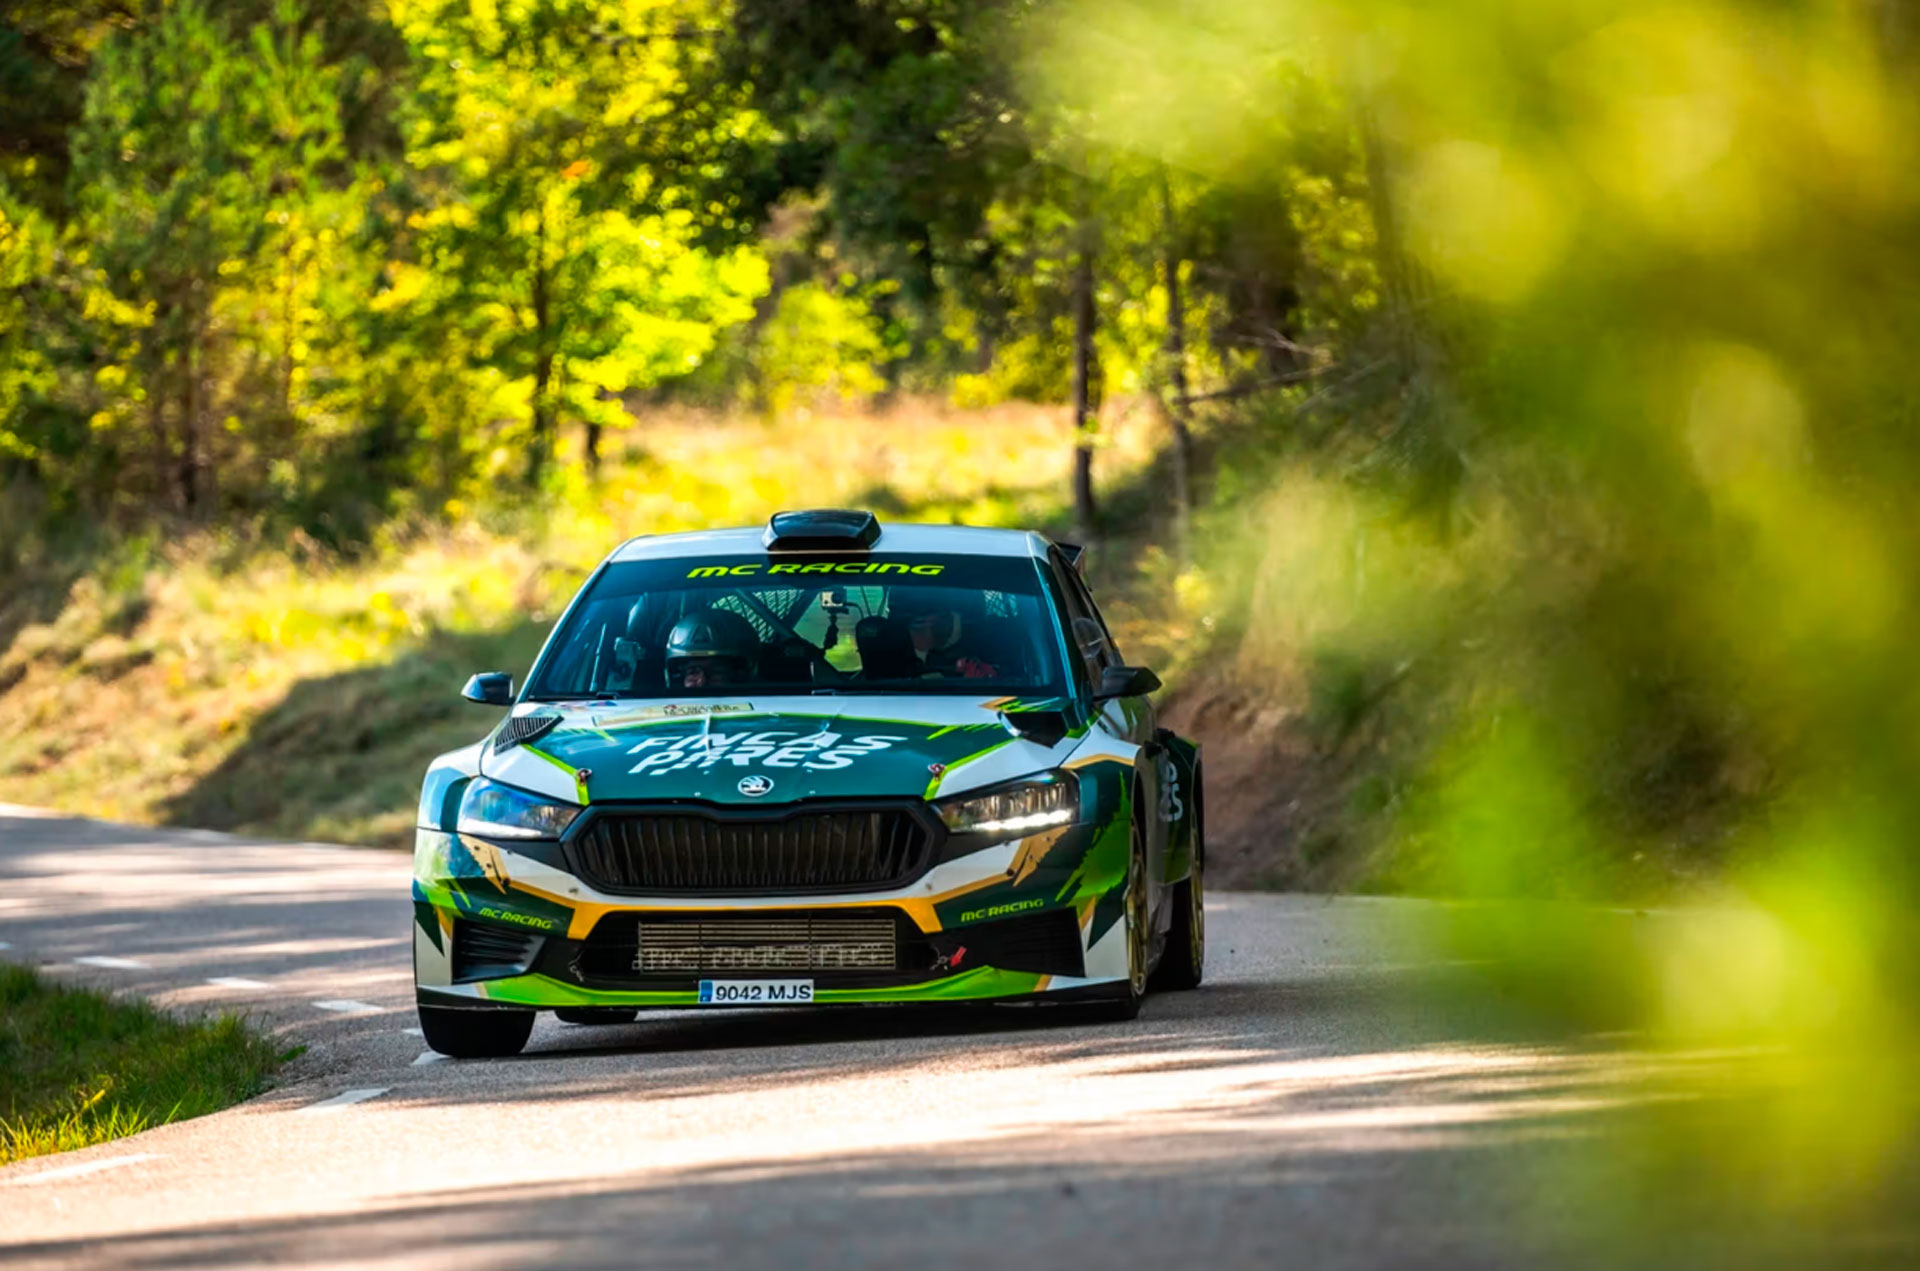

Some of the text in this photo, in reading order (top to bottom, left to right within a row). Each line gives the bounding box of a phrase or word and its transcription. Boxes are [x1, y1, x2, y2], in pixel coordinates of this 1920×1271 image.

[687, 562, 945, 579] MC RACING
[626, 731, 909, 755] FINCAS
[479, 907, 553, 930] MC RACING
[961, 898, 1044, 923] MC RACING
[716, 985, 762, 1001] 9042
[768, 984, 811, 1000] MJS
